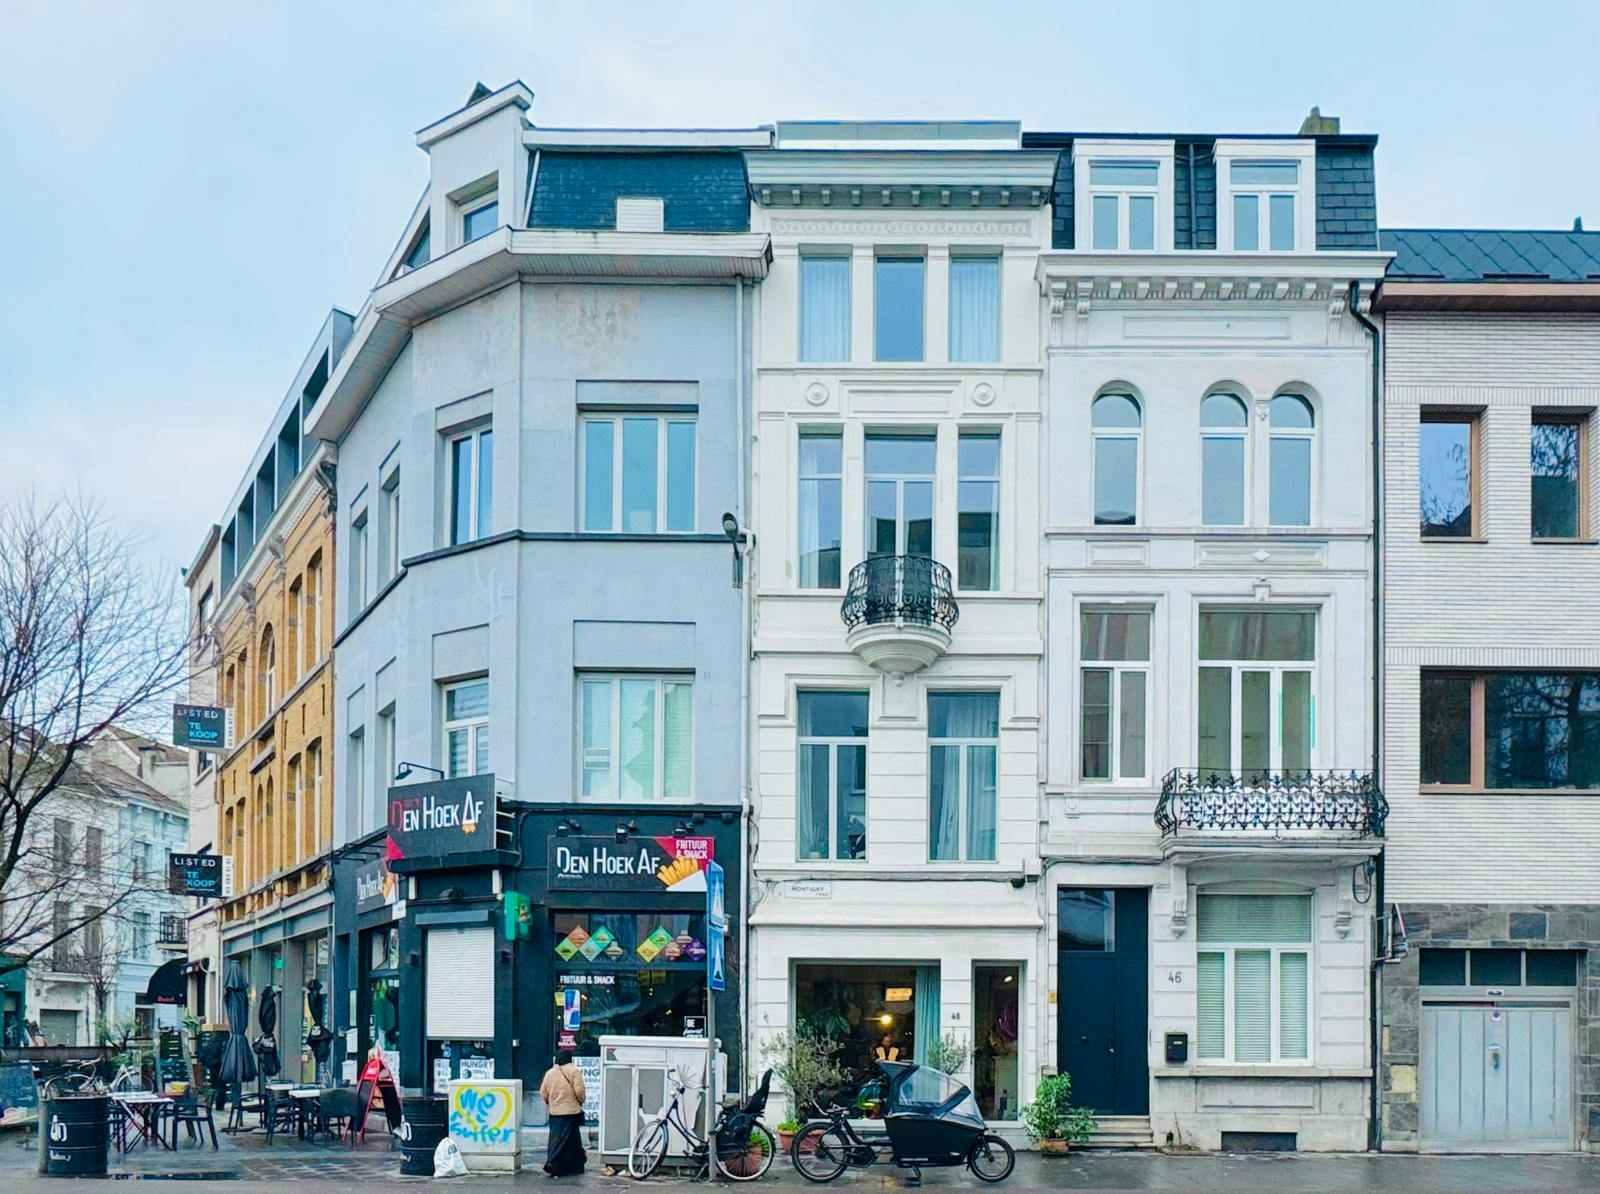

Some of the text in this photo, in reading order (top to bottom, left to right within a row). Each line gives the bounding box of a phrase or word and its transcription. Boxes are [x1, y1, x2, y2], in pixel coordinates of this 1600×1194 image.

[177, 709, 218, 719] LISTED
[188, 721, 201, 731] TE
[188, 730, 218, 739] KOOP
[675, 839, 708, 850] FRITUUR
[684, 850, 708, 859] SNACK
[174, 857, 216, 867] LISTED
[186, 871, 200, 879] TE
[186, 879, 216, 888] KOOP
[559, 975, 615, 985] FRITUUR & SNACK
[1167, 971, 1182, 984] 46
[951, 1011, 961, 1021] 48
[461, 1060, 493, 1069] HUNGRY
